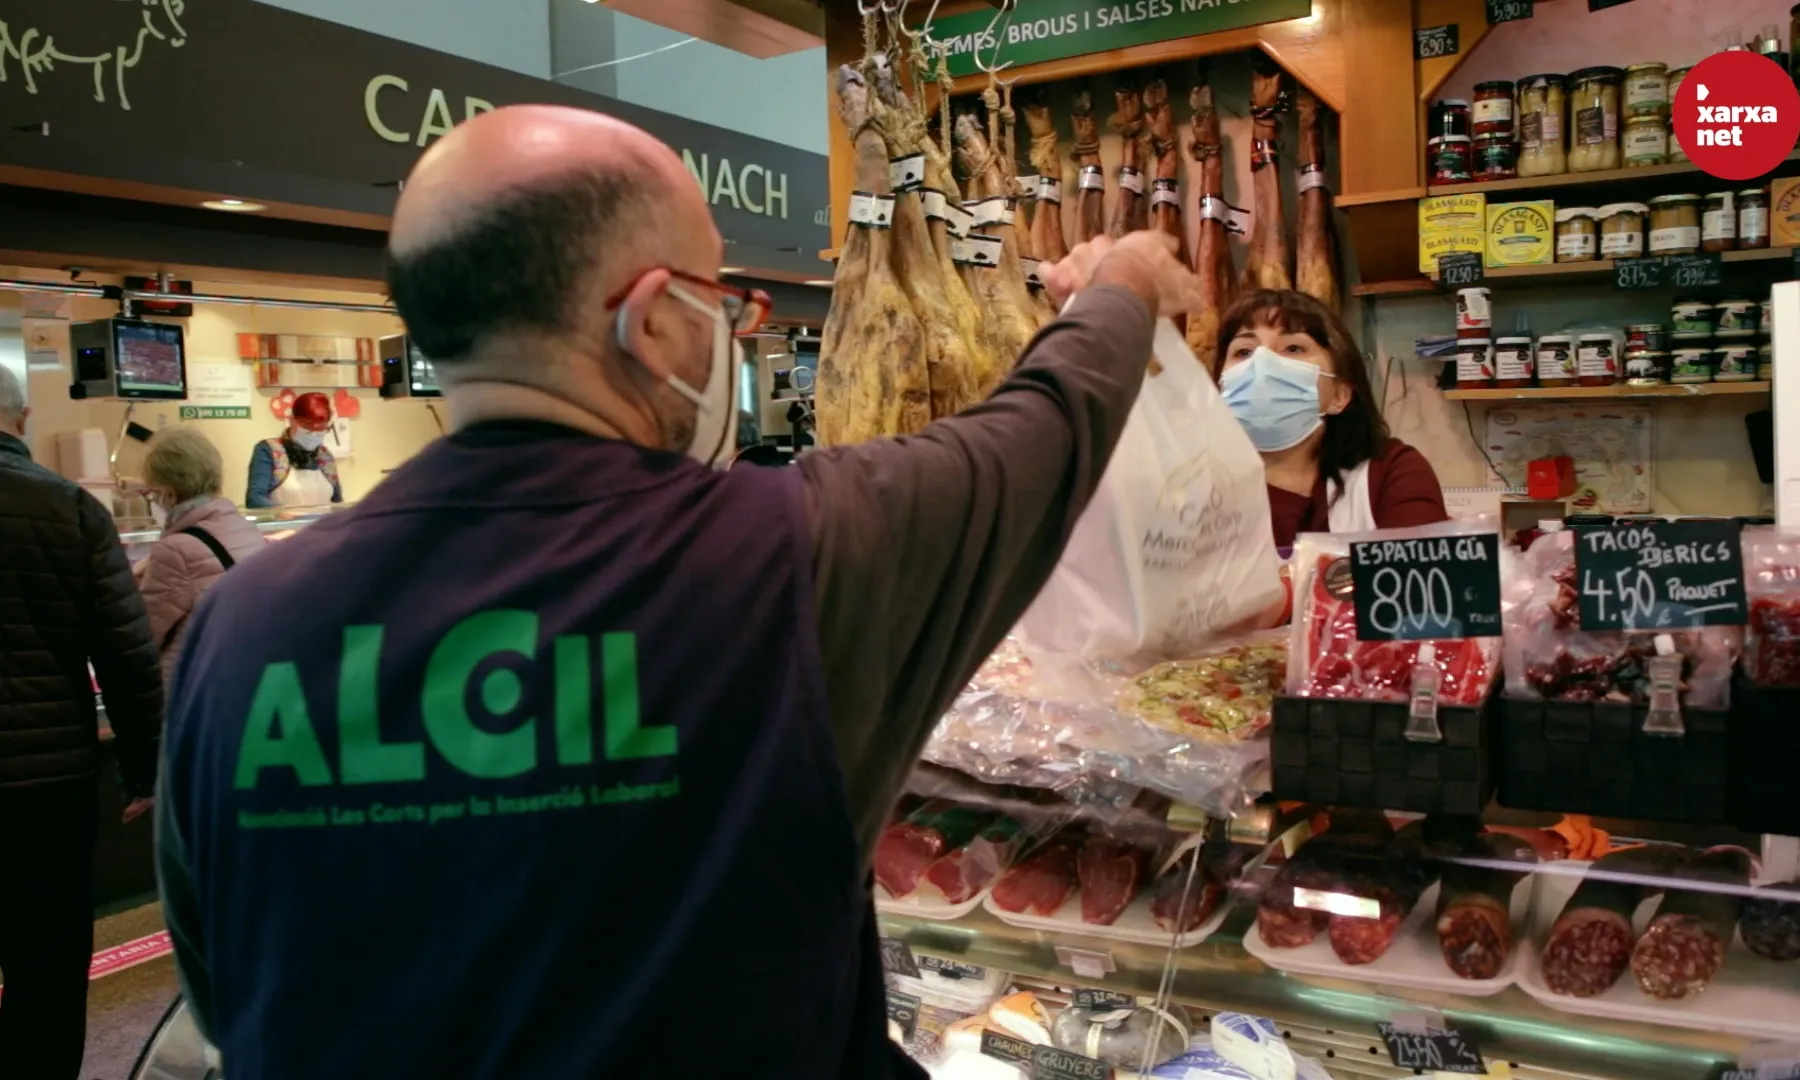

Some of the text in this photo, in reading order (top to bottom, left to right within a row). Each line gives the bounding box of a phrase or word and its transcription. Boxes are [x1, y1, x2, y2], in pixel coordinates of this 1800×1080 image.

[1008, 14, 1078, 44] BROUS
[1084, 11, 1091, 31] I
[1096, 0, 1174, 28] SALSES
[1356, 538, 1451, 565] ESPATLLA
[1583, 528, 1656, 552] TACOS
[1583, 567, 1656, 628] 4.50
[234, 608, 679, 789] ALCIL
[369, 802, 425, 823] Corts
[429, 802, 465, 826] per
[497, 785, 585, 814] Inserció
[591, 775, 680, 805] Laboral
